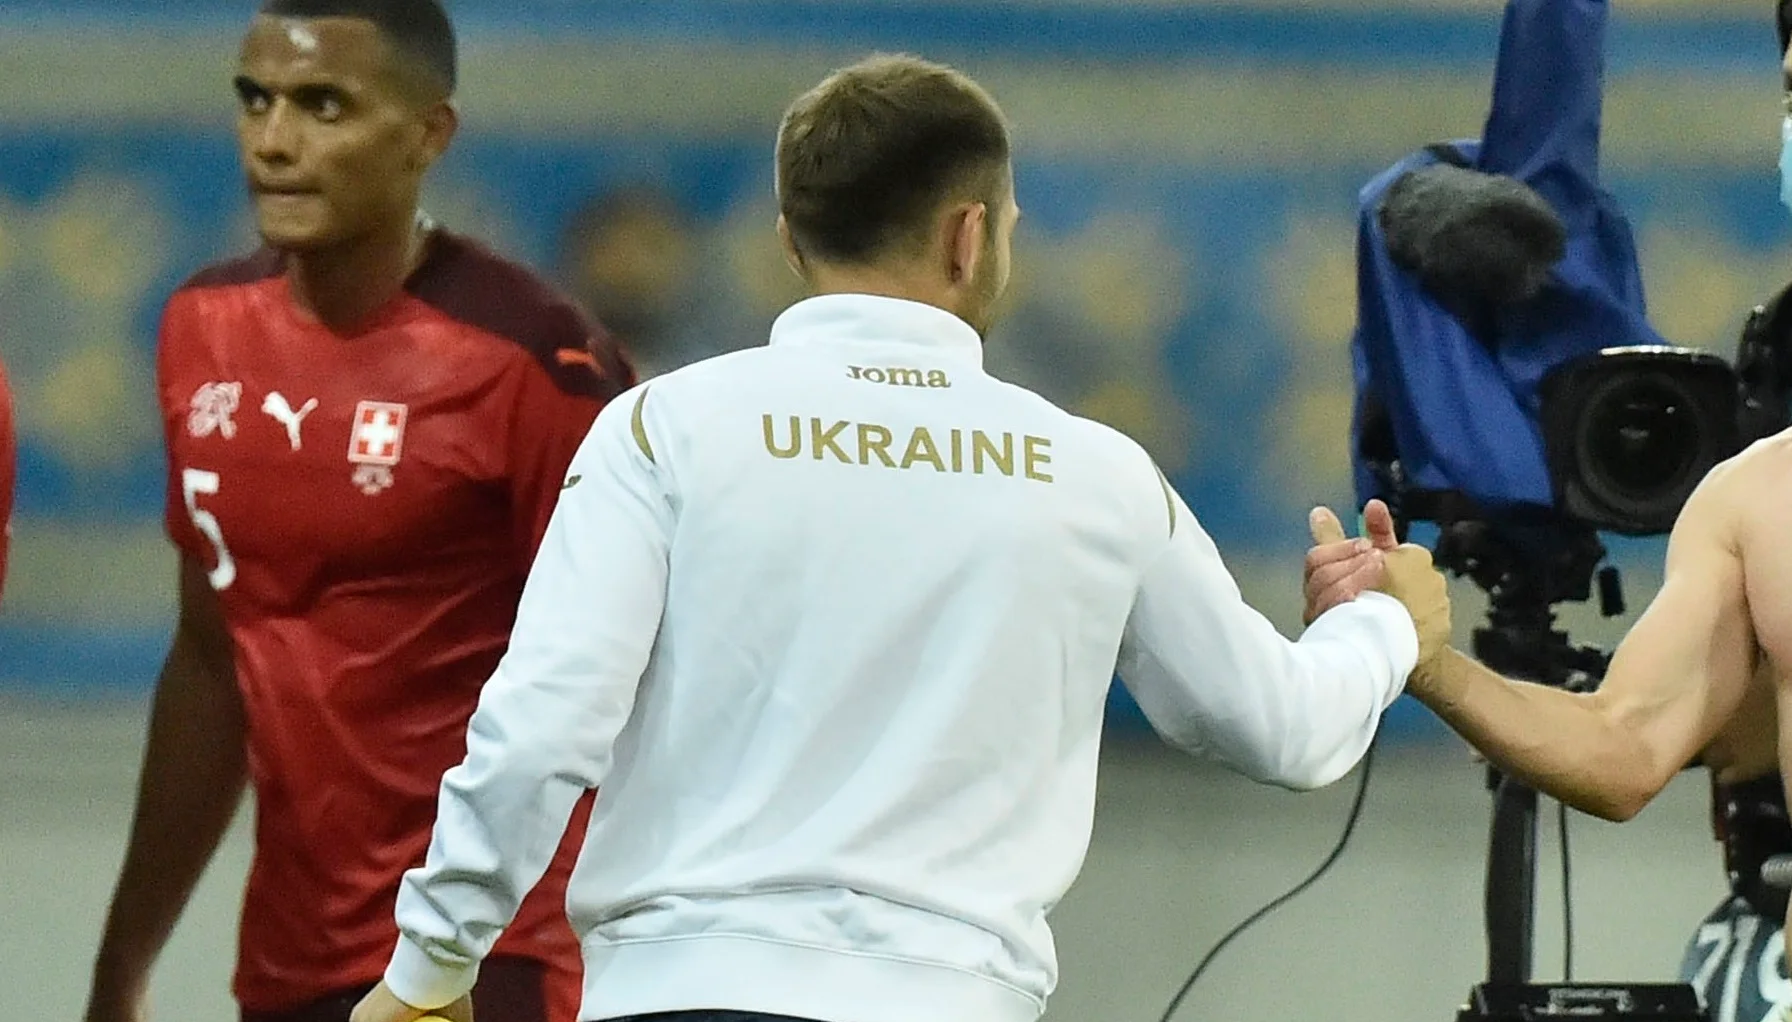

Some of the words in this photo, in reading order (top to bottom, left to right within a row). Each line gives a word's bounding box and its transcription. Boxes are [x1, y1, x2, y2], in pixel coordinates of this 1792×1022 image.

[845, 364, 952, 389] Joma
[761, 413, 1054, 484] UKRAINE
[182, 466, 237, 591] 5
